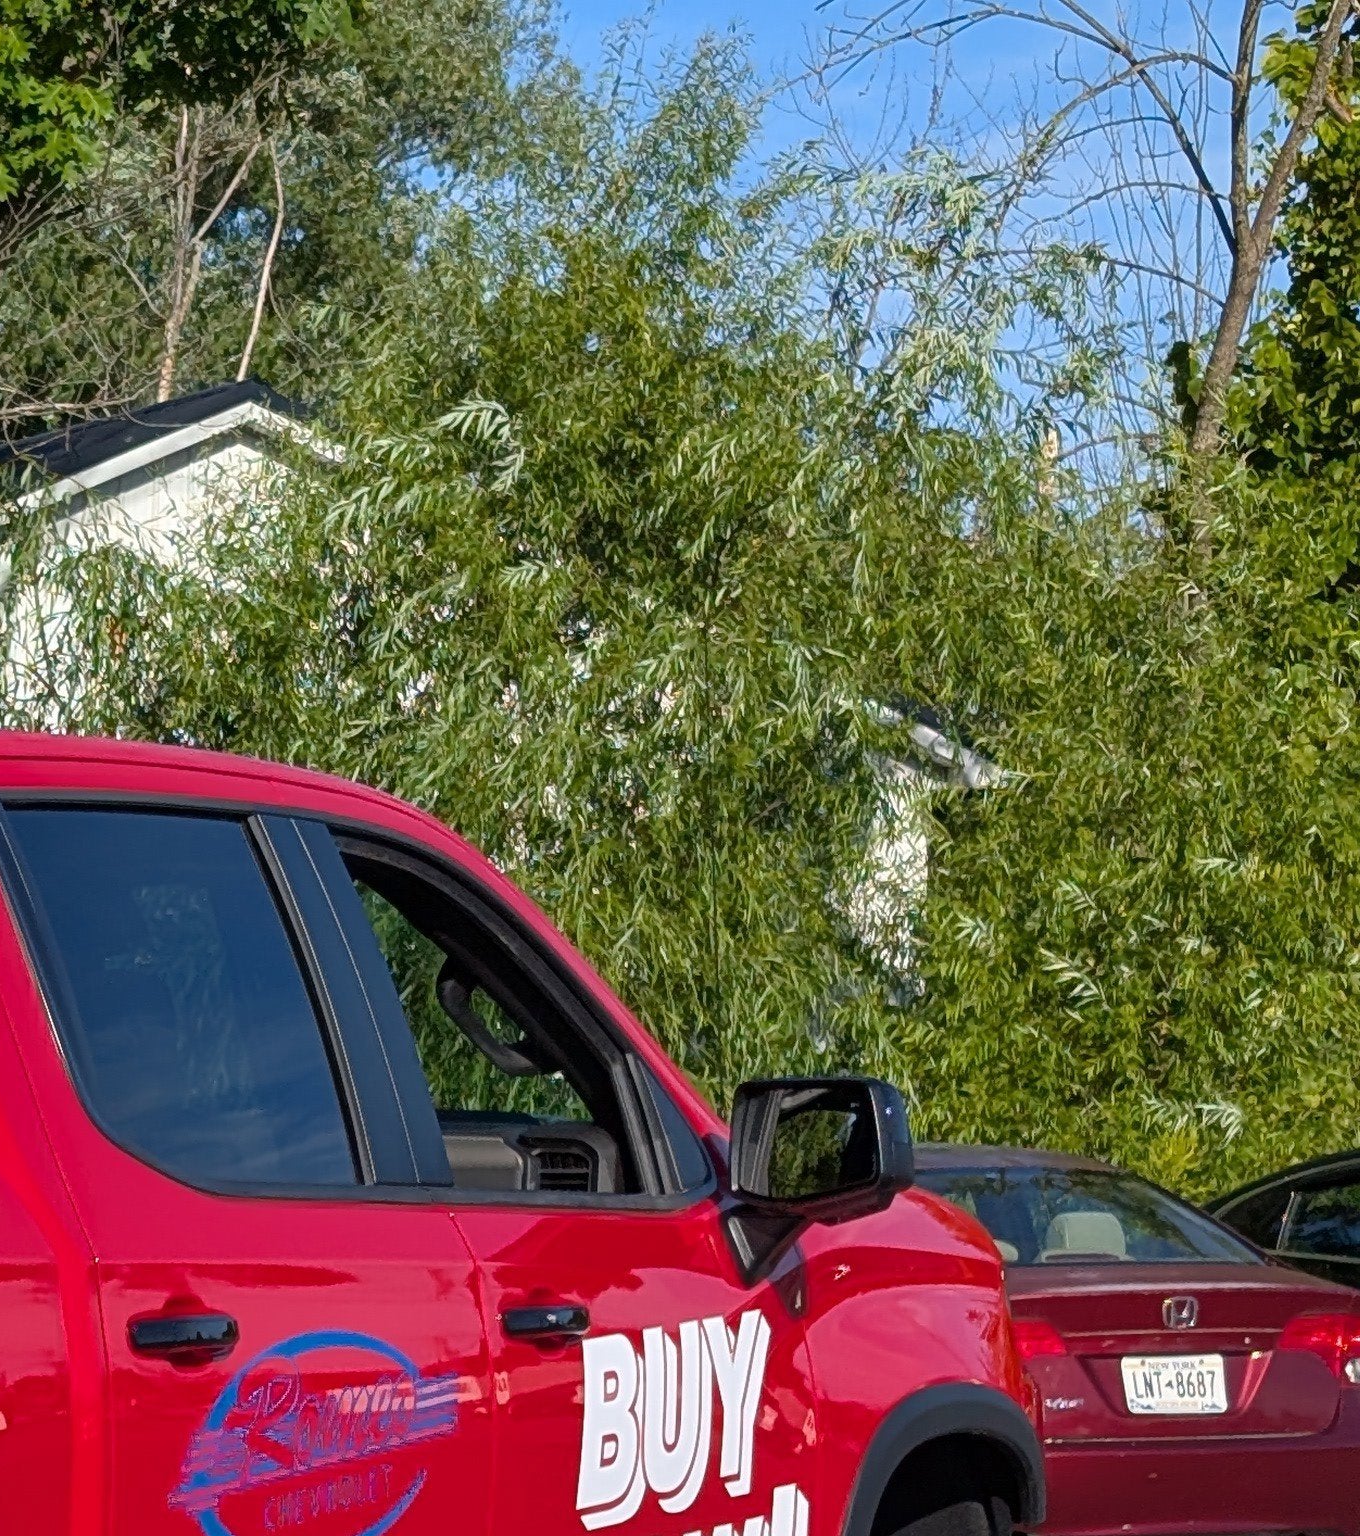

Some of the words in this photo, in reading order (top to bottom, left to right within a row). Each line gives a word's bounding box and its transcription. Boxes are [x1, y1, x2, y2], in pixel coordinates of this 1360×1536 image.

[576, 1308, 771, 1531] BUY
[1132, 1370, 1162, 1399] LNT
[1175, 1368, 1216, 1399] 8687
